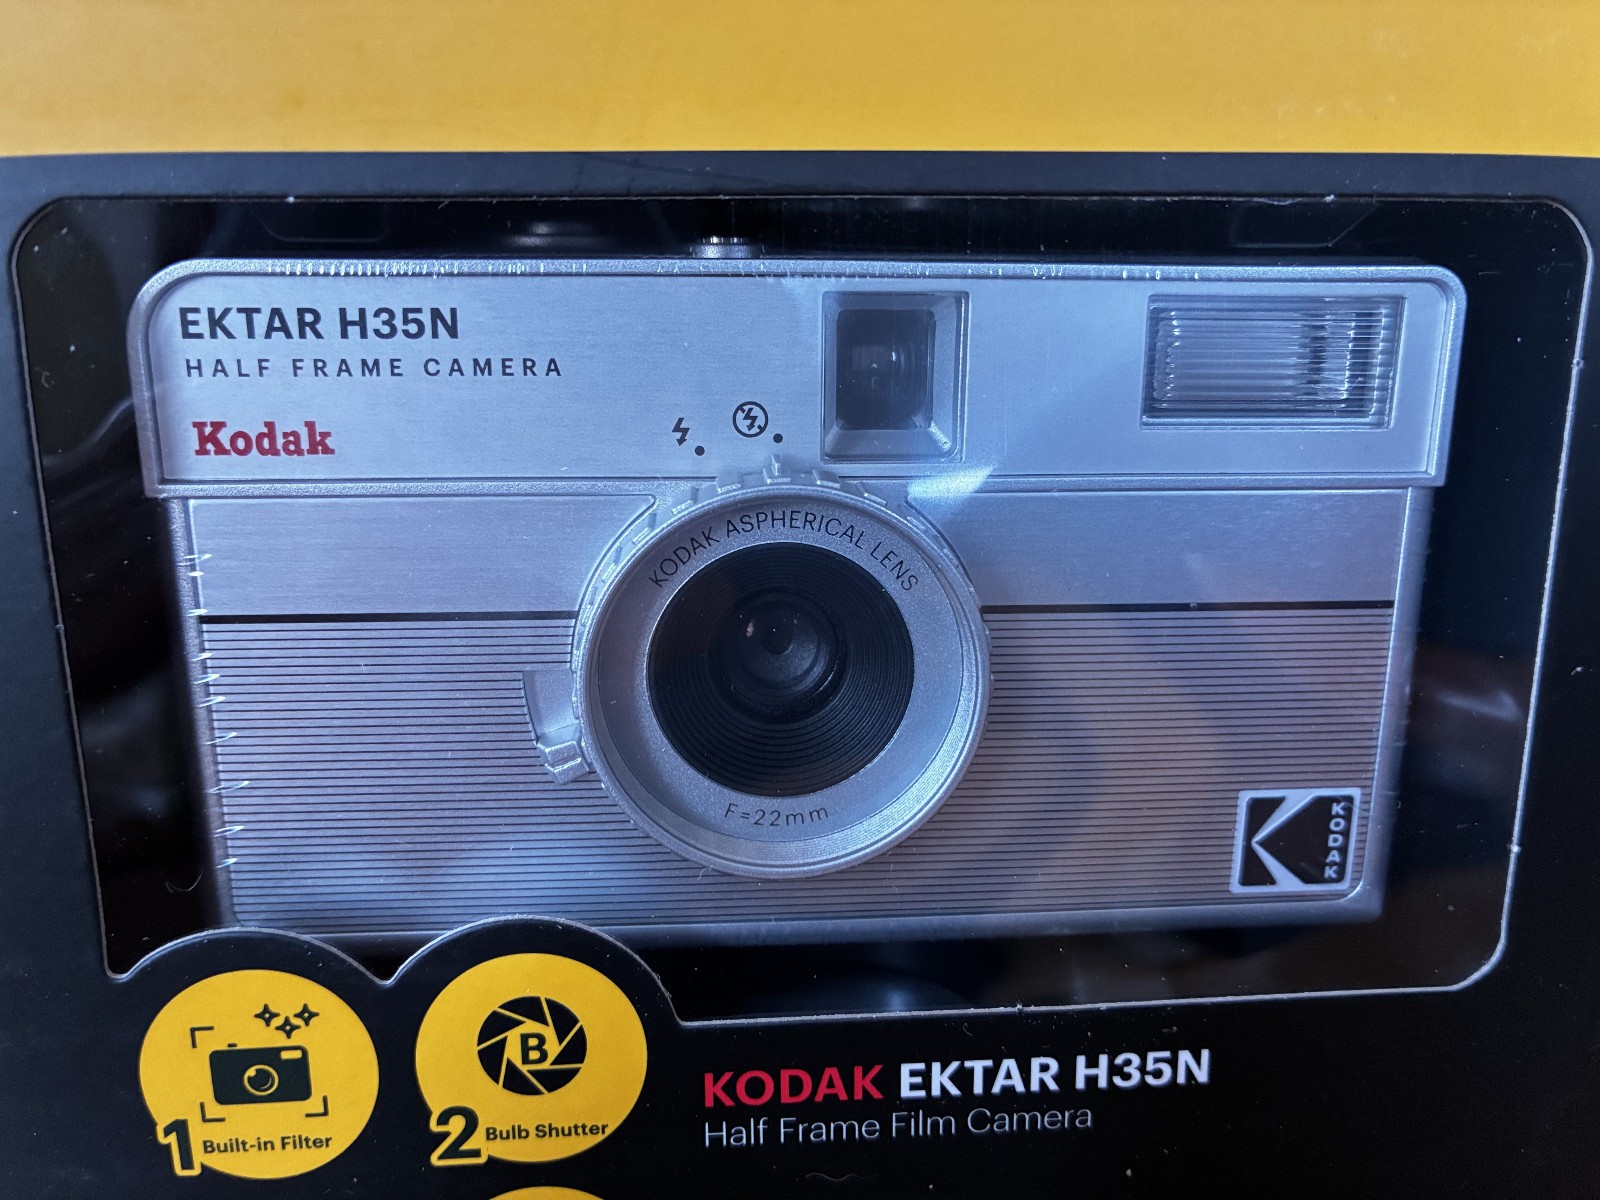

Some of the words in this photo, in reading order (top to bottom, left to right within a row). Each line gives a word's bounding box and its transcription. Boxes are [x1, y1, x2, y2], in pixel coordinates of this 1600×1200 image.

[179, 306, 325, 340] EKTAR
[339, 306, 460, 339] H35N
[185, 358, 271, 379] HALF
[292, 358, 404, 377] FRAME
[423, 357, 563, 377] CAMERA
[193, 420, 335, 457] Kodak
[648, 526, 721, 588] KODAK
[726, 510, 865, 549] ASPHERICAL
[869, 541, 919, 591] LENS
[724, 803, 829, 827] F=22mm
[1323, 802, 1346, 880] KODAK
[520, 1032, 549, 1065] B
[703, 1064, 885, 1107] KODAK
[900, 1056, 1060, 1100] EKTAR
[1075, 1049, 1211, 1090] H35N
[162, 1119, 196, 1171] 1
[202, 1135, 275, 1155] Built-in
[281, 1132, 333, 1151] Filter
[435, 1107, 482, 1161] 2
[485, 1123, 530, 1141] Bulb
[536, 1119, 609, 1139] Shutter
[704, 1116, 769, 1148] Half
[780, 1115, 881, 1144] Frame
[892, 1110, 956, 1138] Film
[967, 1107, 1093, 1133] Camera
